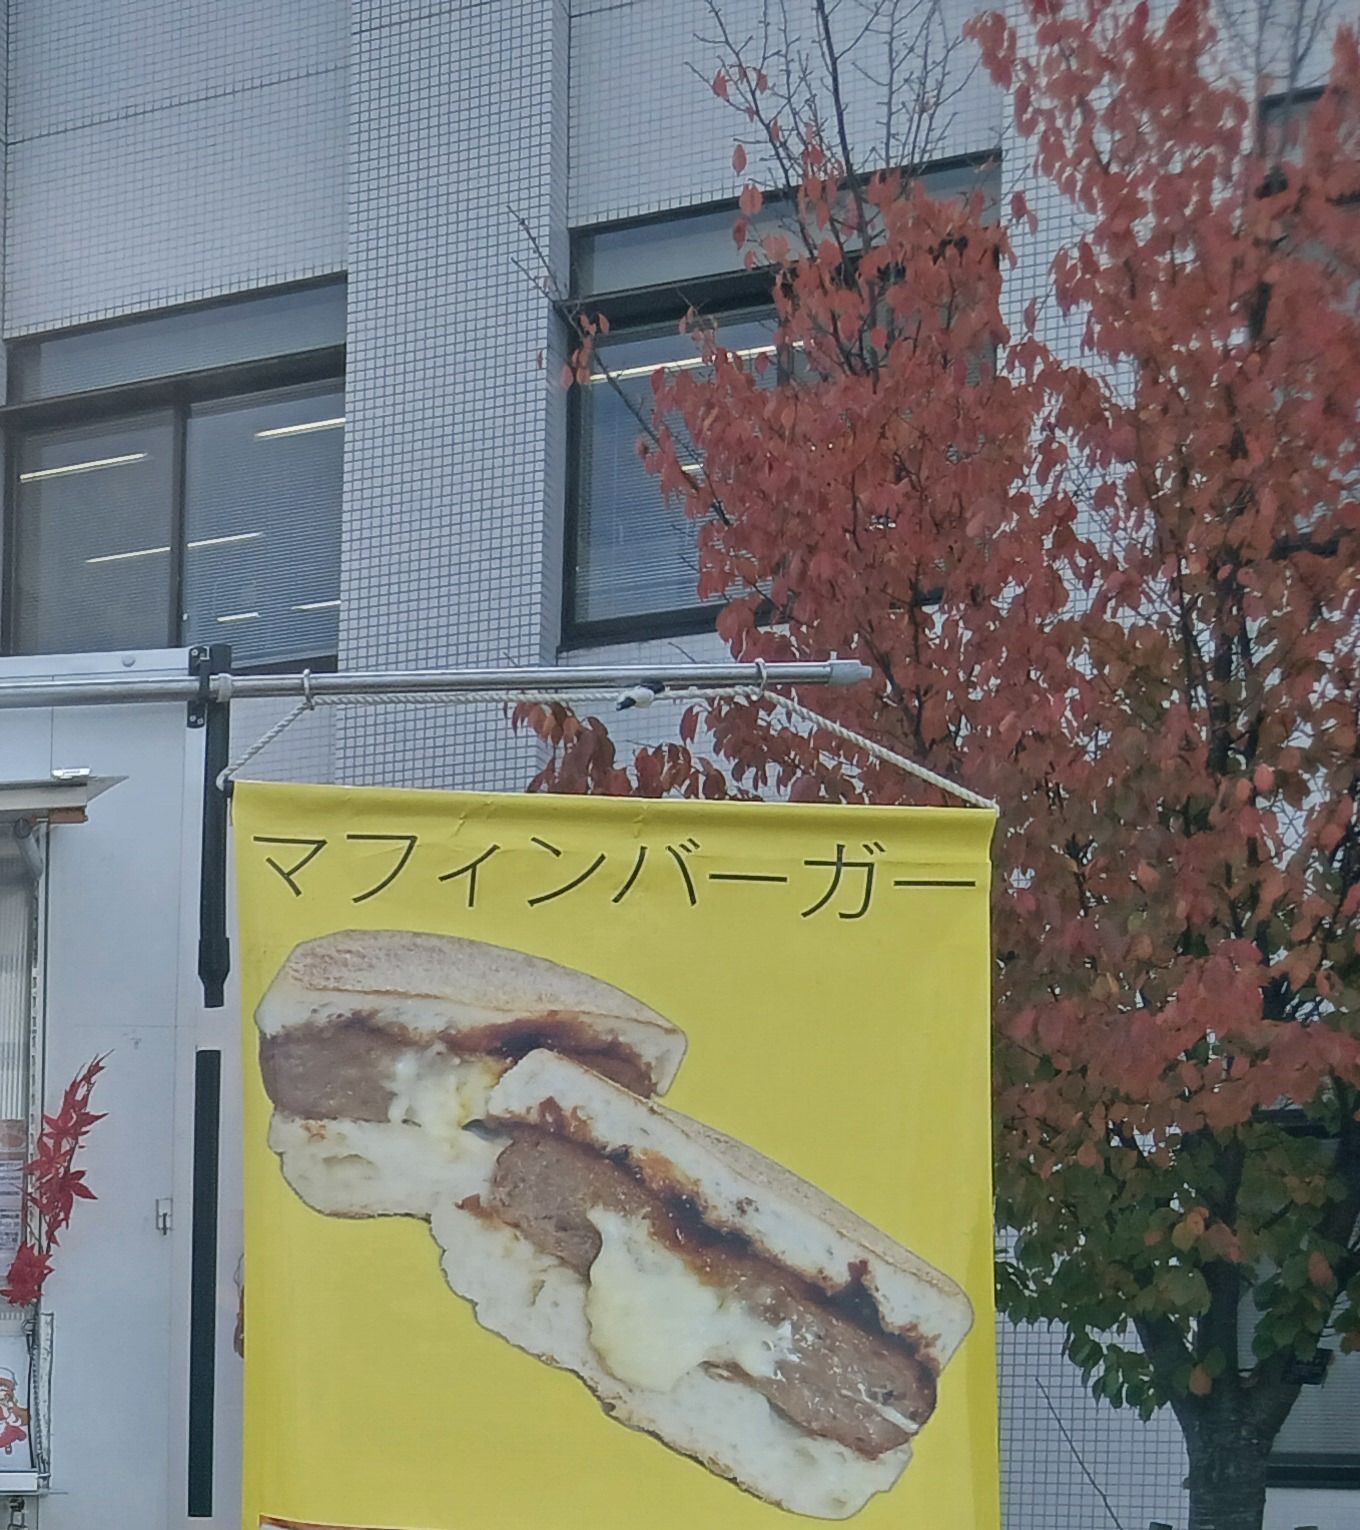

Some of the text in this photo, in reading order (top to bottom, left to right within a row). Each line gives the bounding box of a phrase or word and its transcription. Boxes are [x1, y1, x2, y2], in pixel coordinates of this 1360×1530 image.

[252, 835, 977, 921] マフィンバーガー
